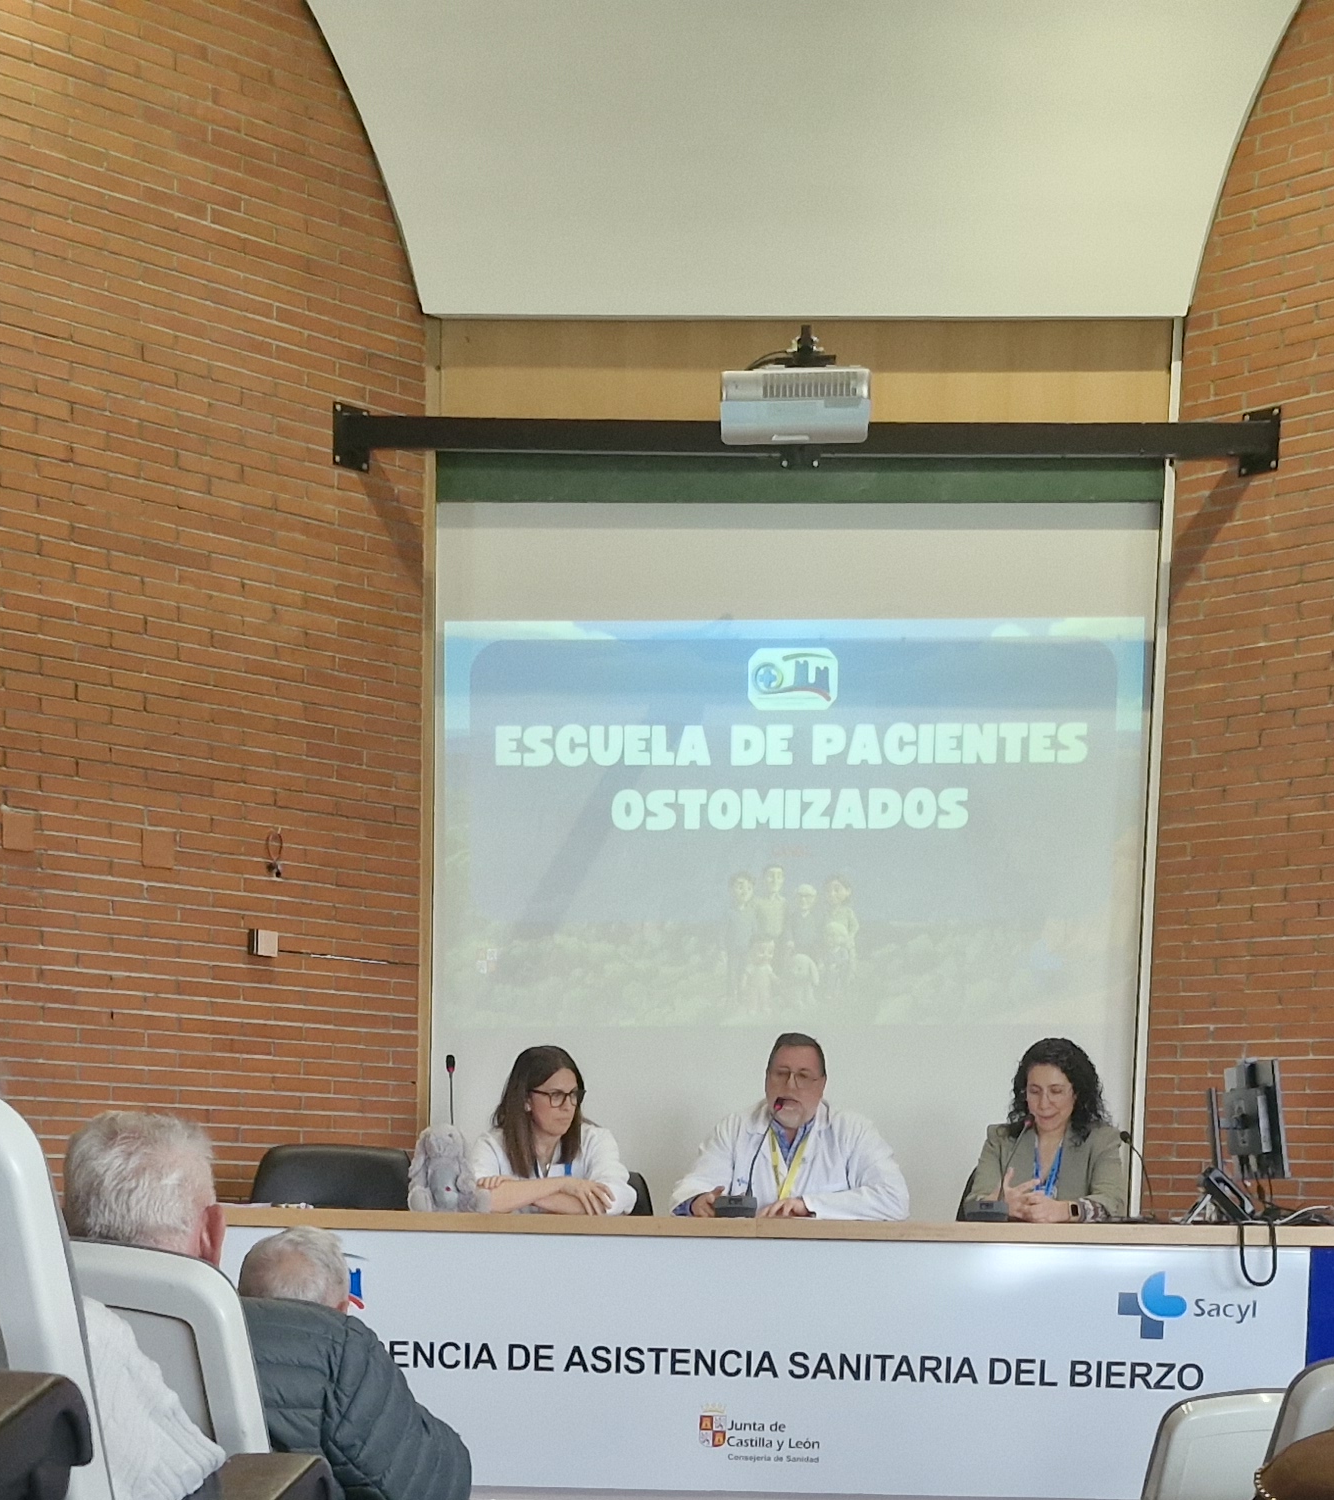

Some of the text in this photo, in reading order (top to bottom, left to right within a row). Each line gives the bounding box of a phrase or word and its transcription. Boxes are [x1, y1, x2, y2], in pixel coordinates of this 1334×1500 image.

[495, 722, 1088, 767] ESCUELA DE PACIENTES
[611, 787, 968, 831] OSTOMIZADOS
[1193, 1298, 1257, 1324] Sacyl
[389, 1340, 1204, 1391] ENCIA DE ASISTENCIA SANITARIA DEL BIERZO
[727, 1419, 786, 1432] Junta de
[727, 1436, 820, 1451] Castilla y León
